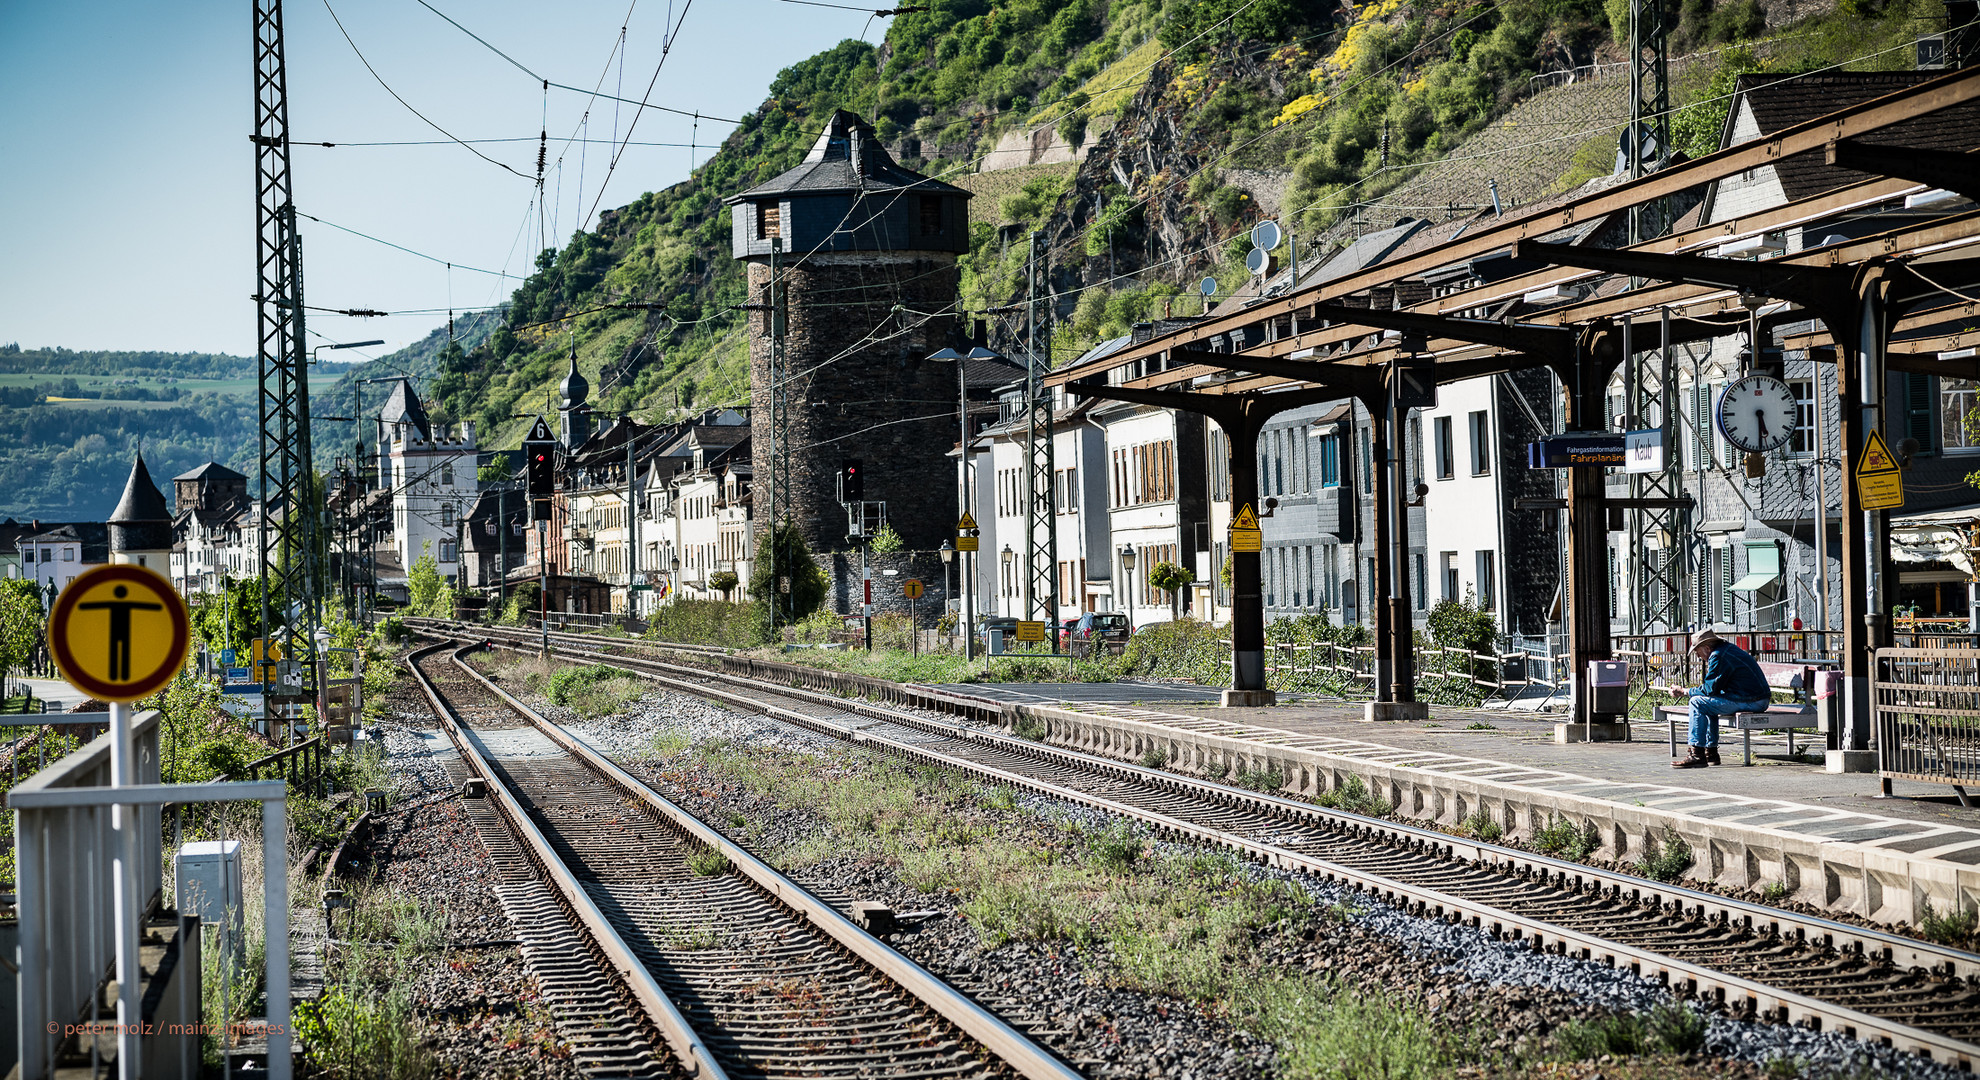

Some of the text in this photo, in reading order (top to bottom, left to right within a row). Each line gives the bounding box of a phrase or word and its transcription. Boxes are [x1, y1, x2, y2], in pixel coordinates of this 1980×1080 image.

[537, 423, 544, 438] 6
[1566, 446, 1624, 454] Fahrgastinformation
[1635, 438, 1652, 460] Kaub
[224, 651, 232, 661] P
